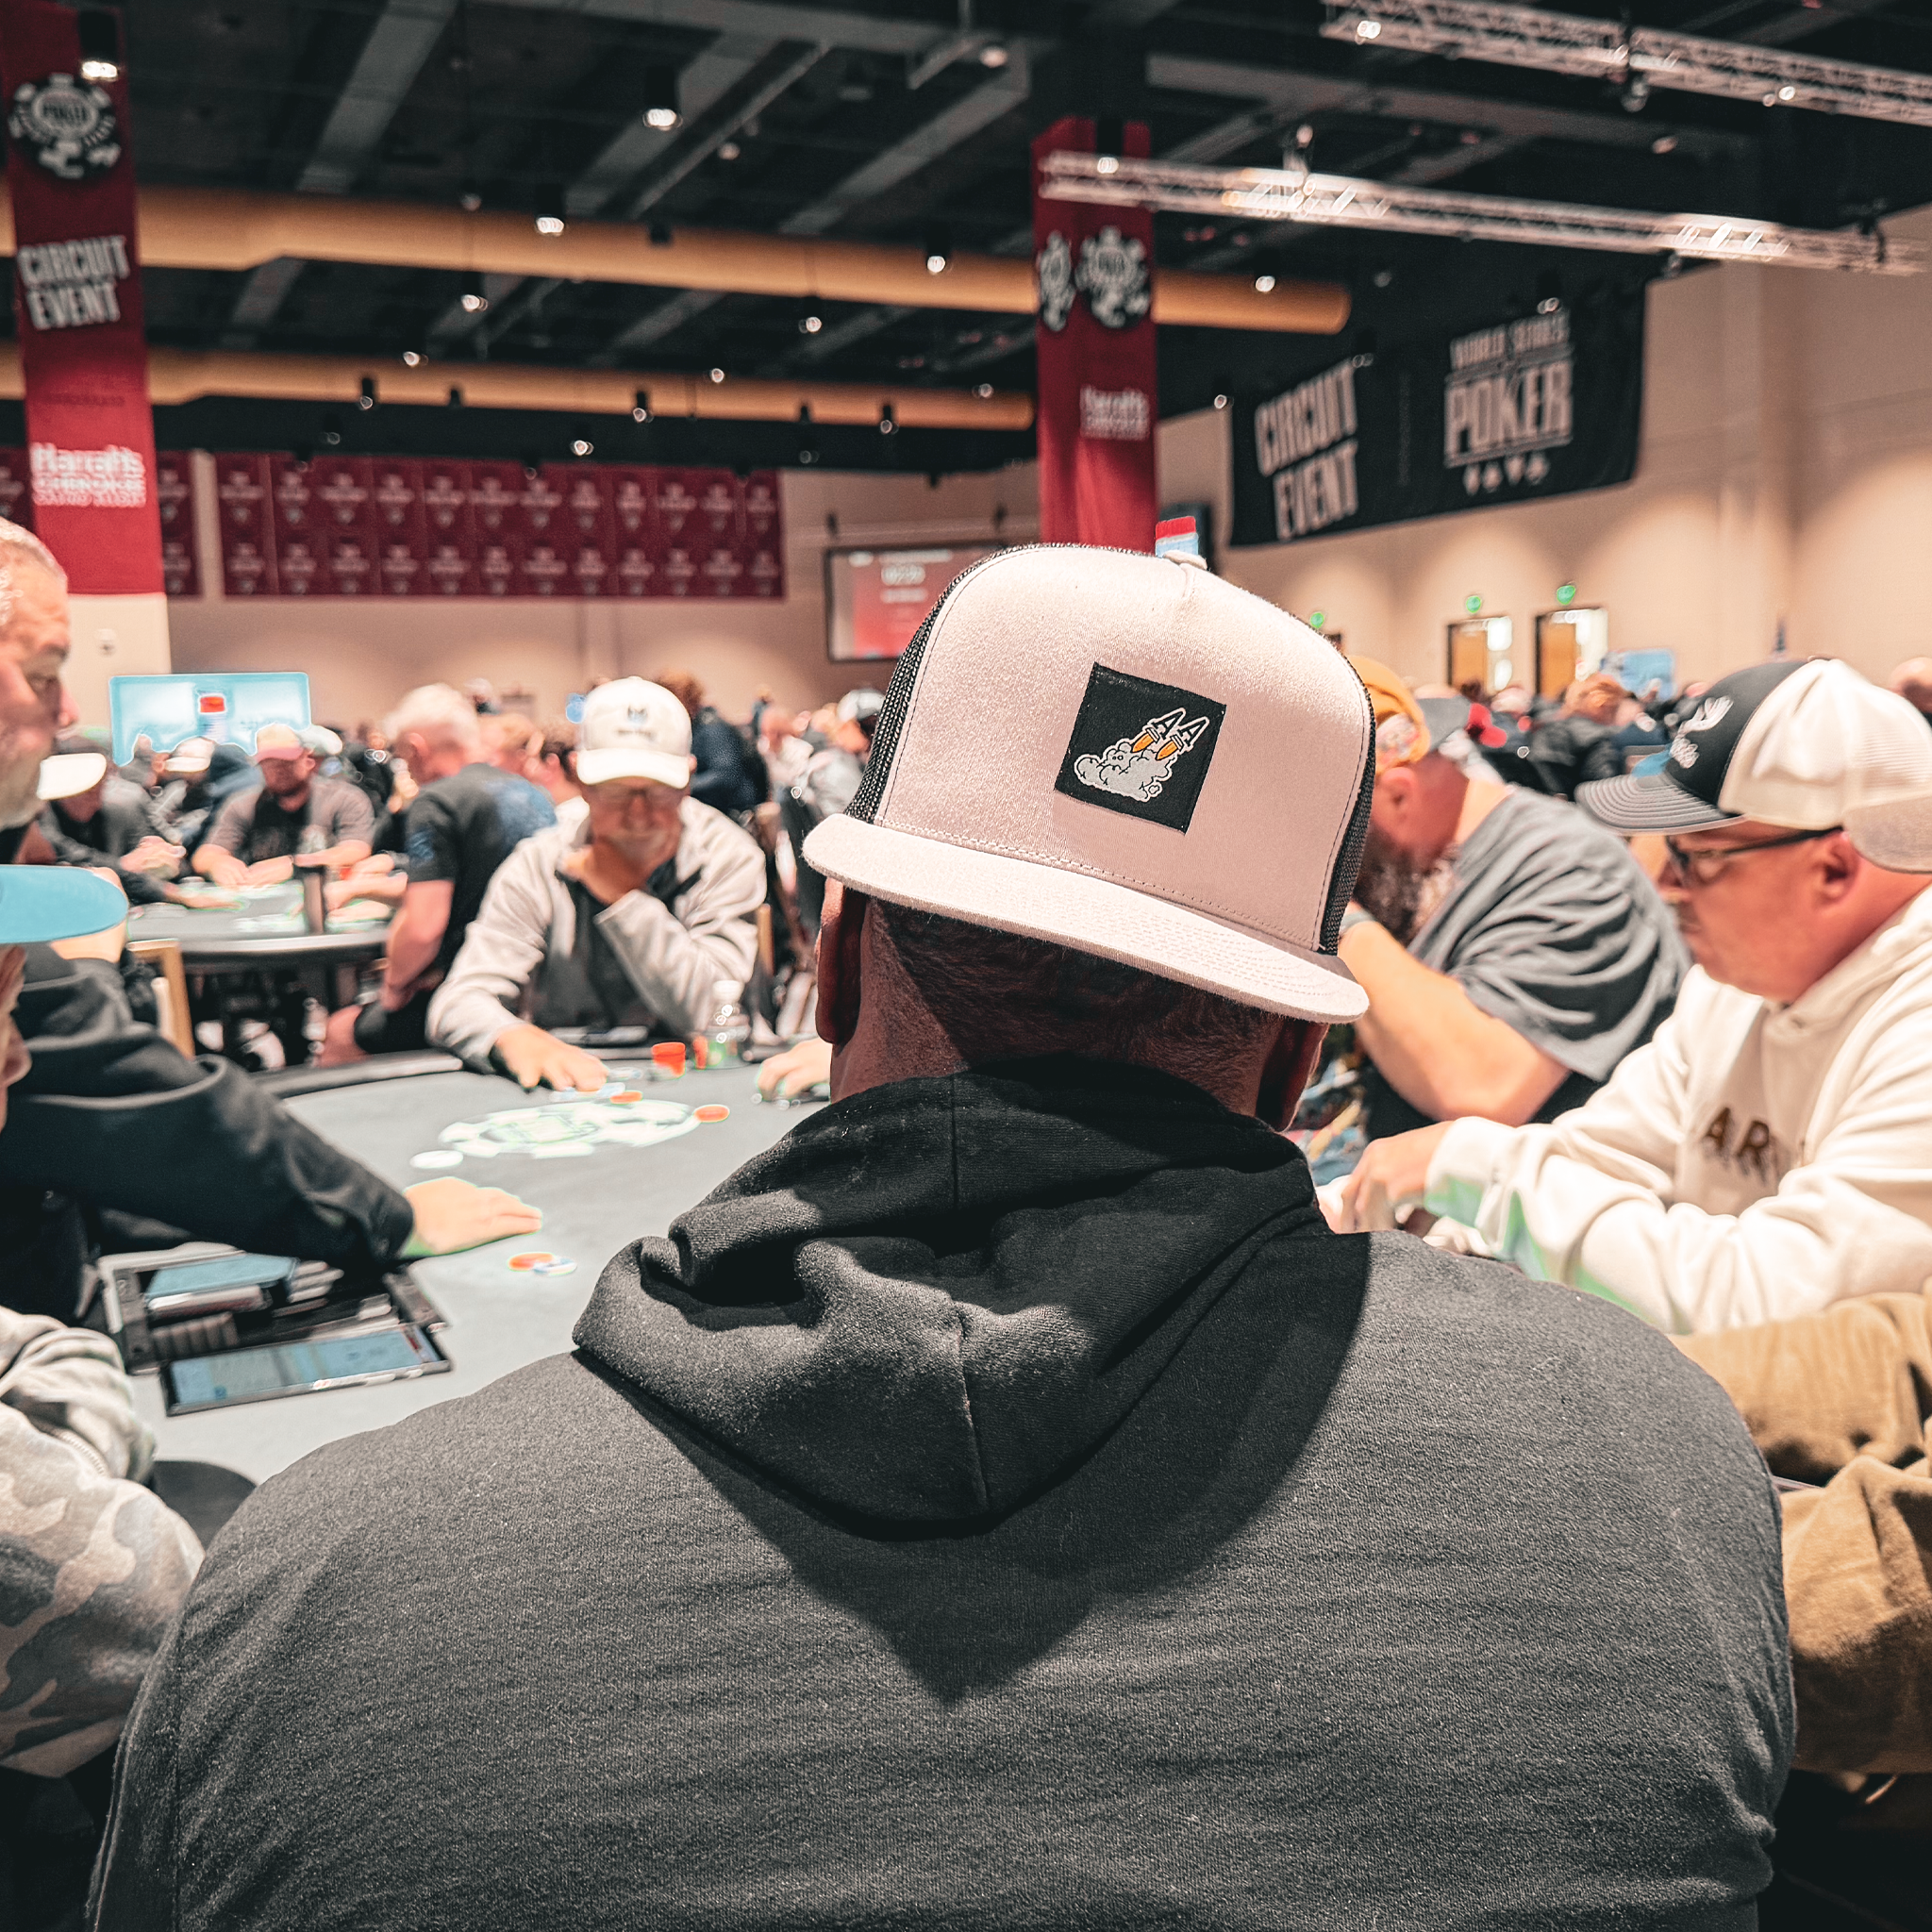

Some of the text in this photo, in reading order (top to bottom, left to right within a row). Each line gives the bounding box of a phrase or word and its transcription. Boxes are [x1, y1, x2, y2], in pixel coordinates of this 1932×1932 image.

[19, 236, 130, 287] CIRCUIT
[27, 280, 121, 330] EVENT
[1256, 358, 1357, 476] CIRCUIT
[1444, 361, 1574, 462] POKER
[1274, 440, 1357, 541] EVENT
